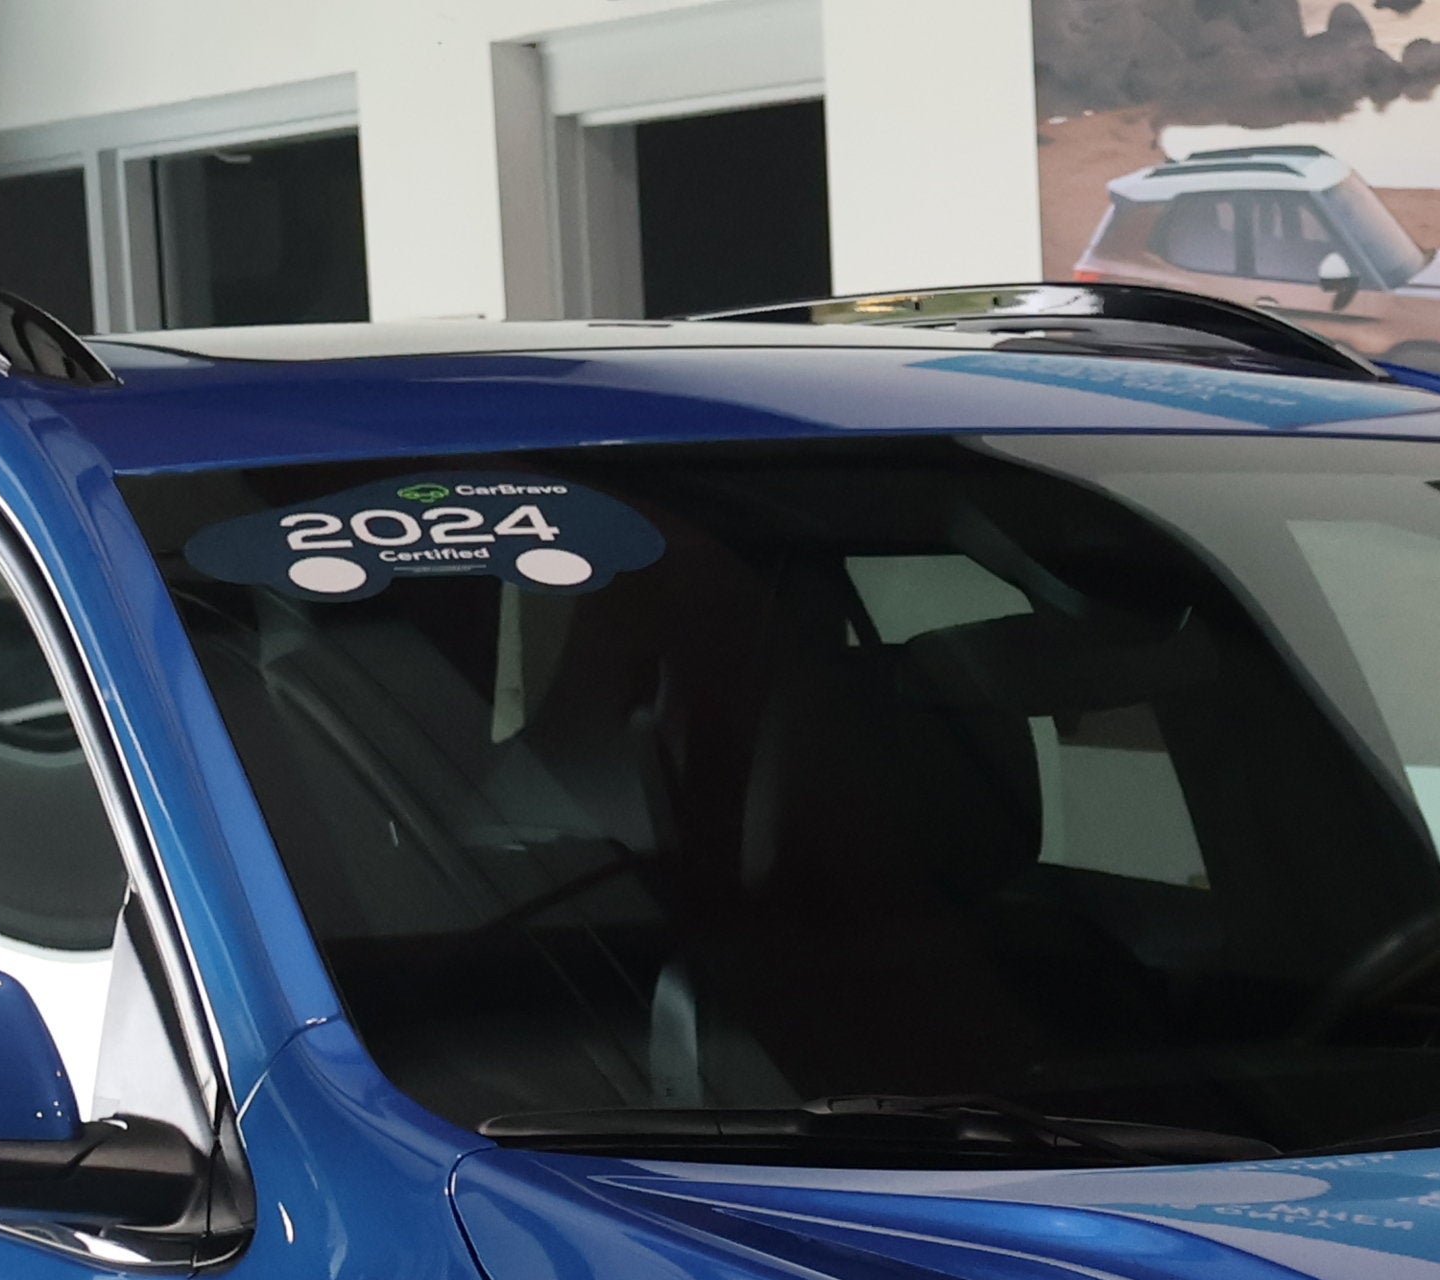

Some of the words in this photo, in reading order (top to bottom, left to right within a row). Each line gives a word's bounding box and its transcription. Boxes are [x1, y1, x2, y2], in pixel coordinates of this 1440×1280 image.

[455, 484, 568, 496] CarBravo
[280, 505, 560, 549] 2024
[379, 548, 490, 562] Certified
